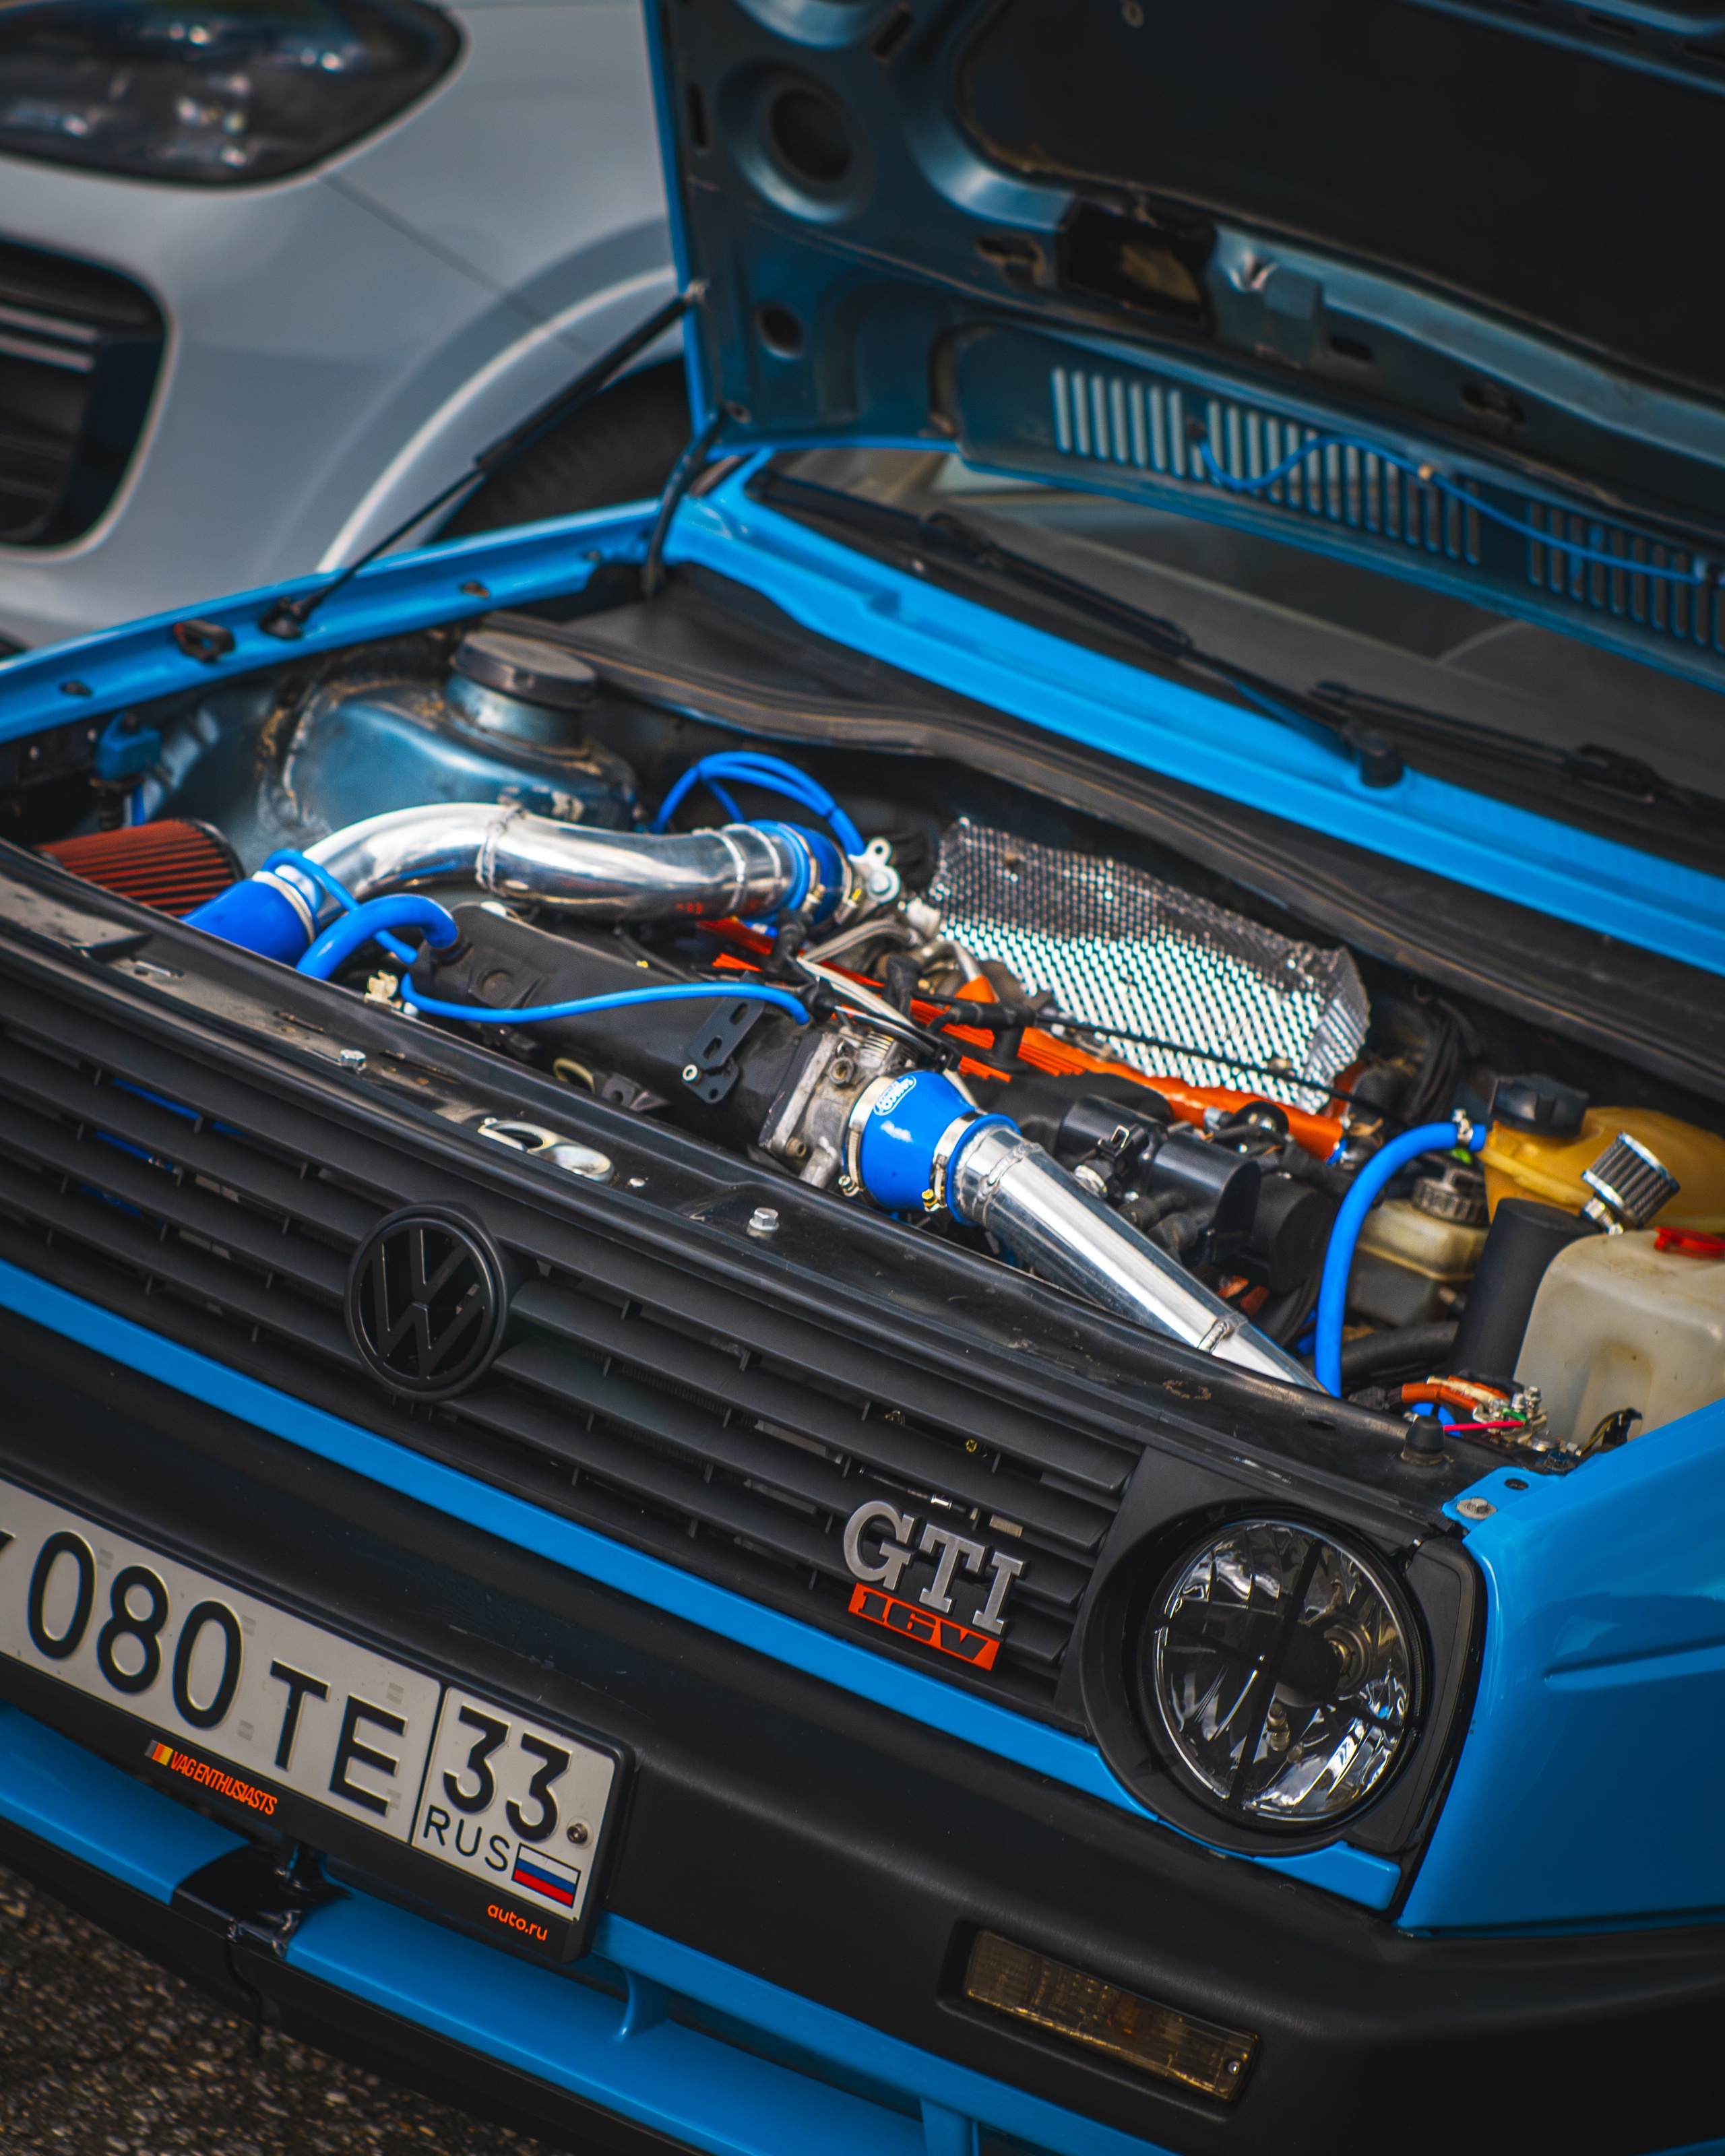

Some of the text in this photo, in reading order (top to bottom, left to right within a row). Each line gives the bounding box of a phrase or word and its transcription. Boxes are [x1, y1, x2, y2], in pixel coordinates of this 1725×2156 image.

[844, 1500, 1024, 1635] GTI
[856, 1591, 990, 1661] 16V
[170, 1750, 278, 1815] VAG ENTHUSIASTS
[443, 1704, 571, 1841] 33
[423, 1804, 510, 1872] RUS
[487, 1904, 548, 1941] auto.ru
